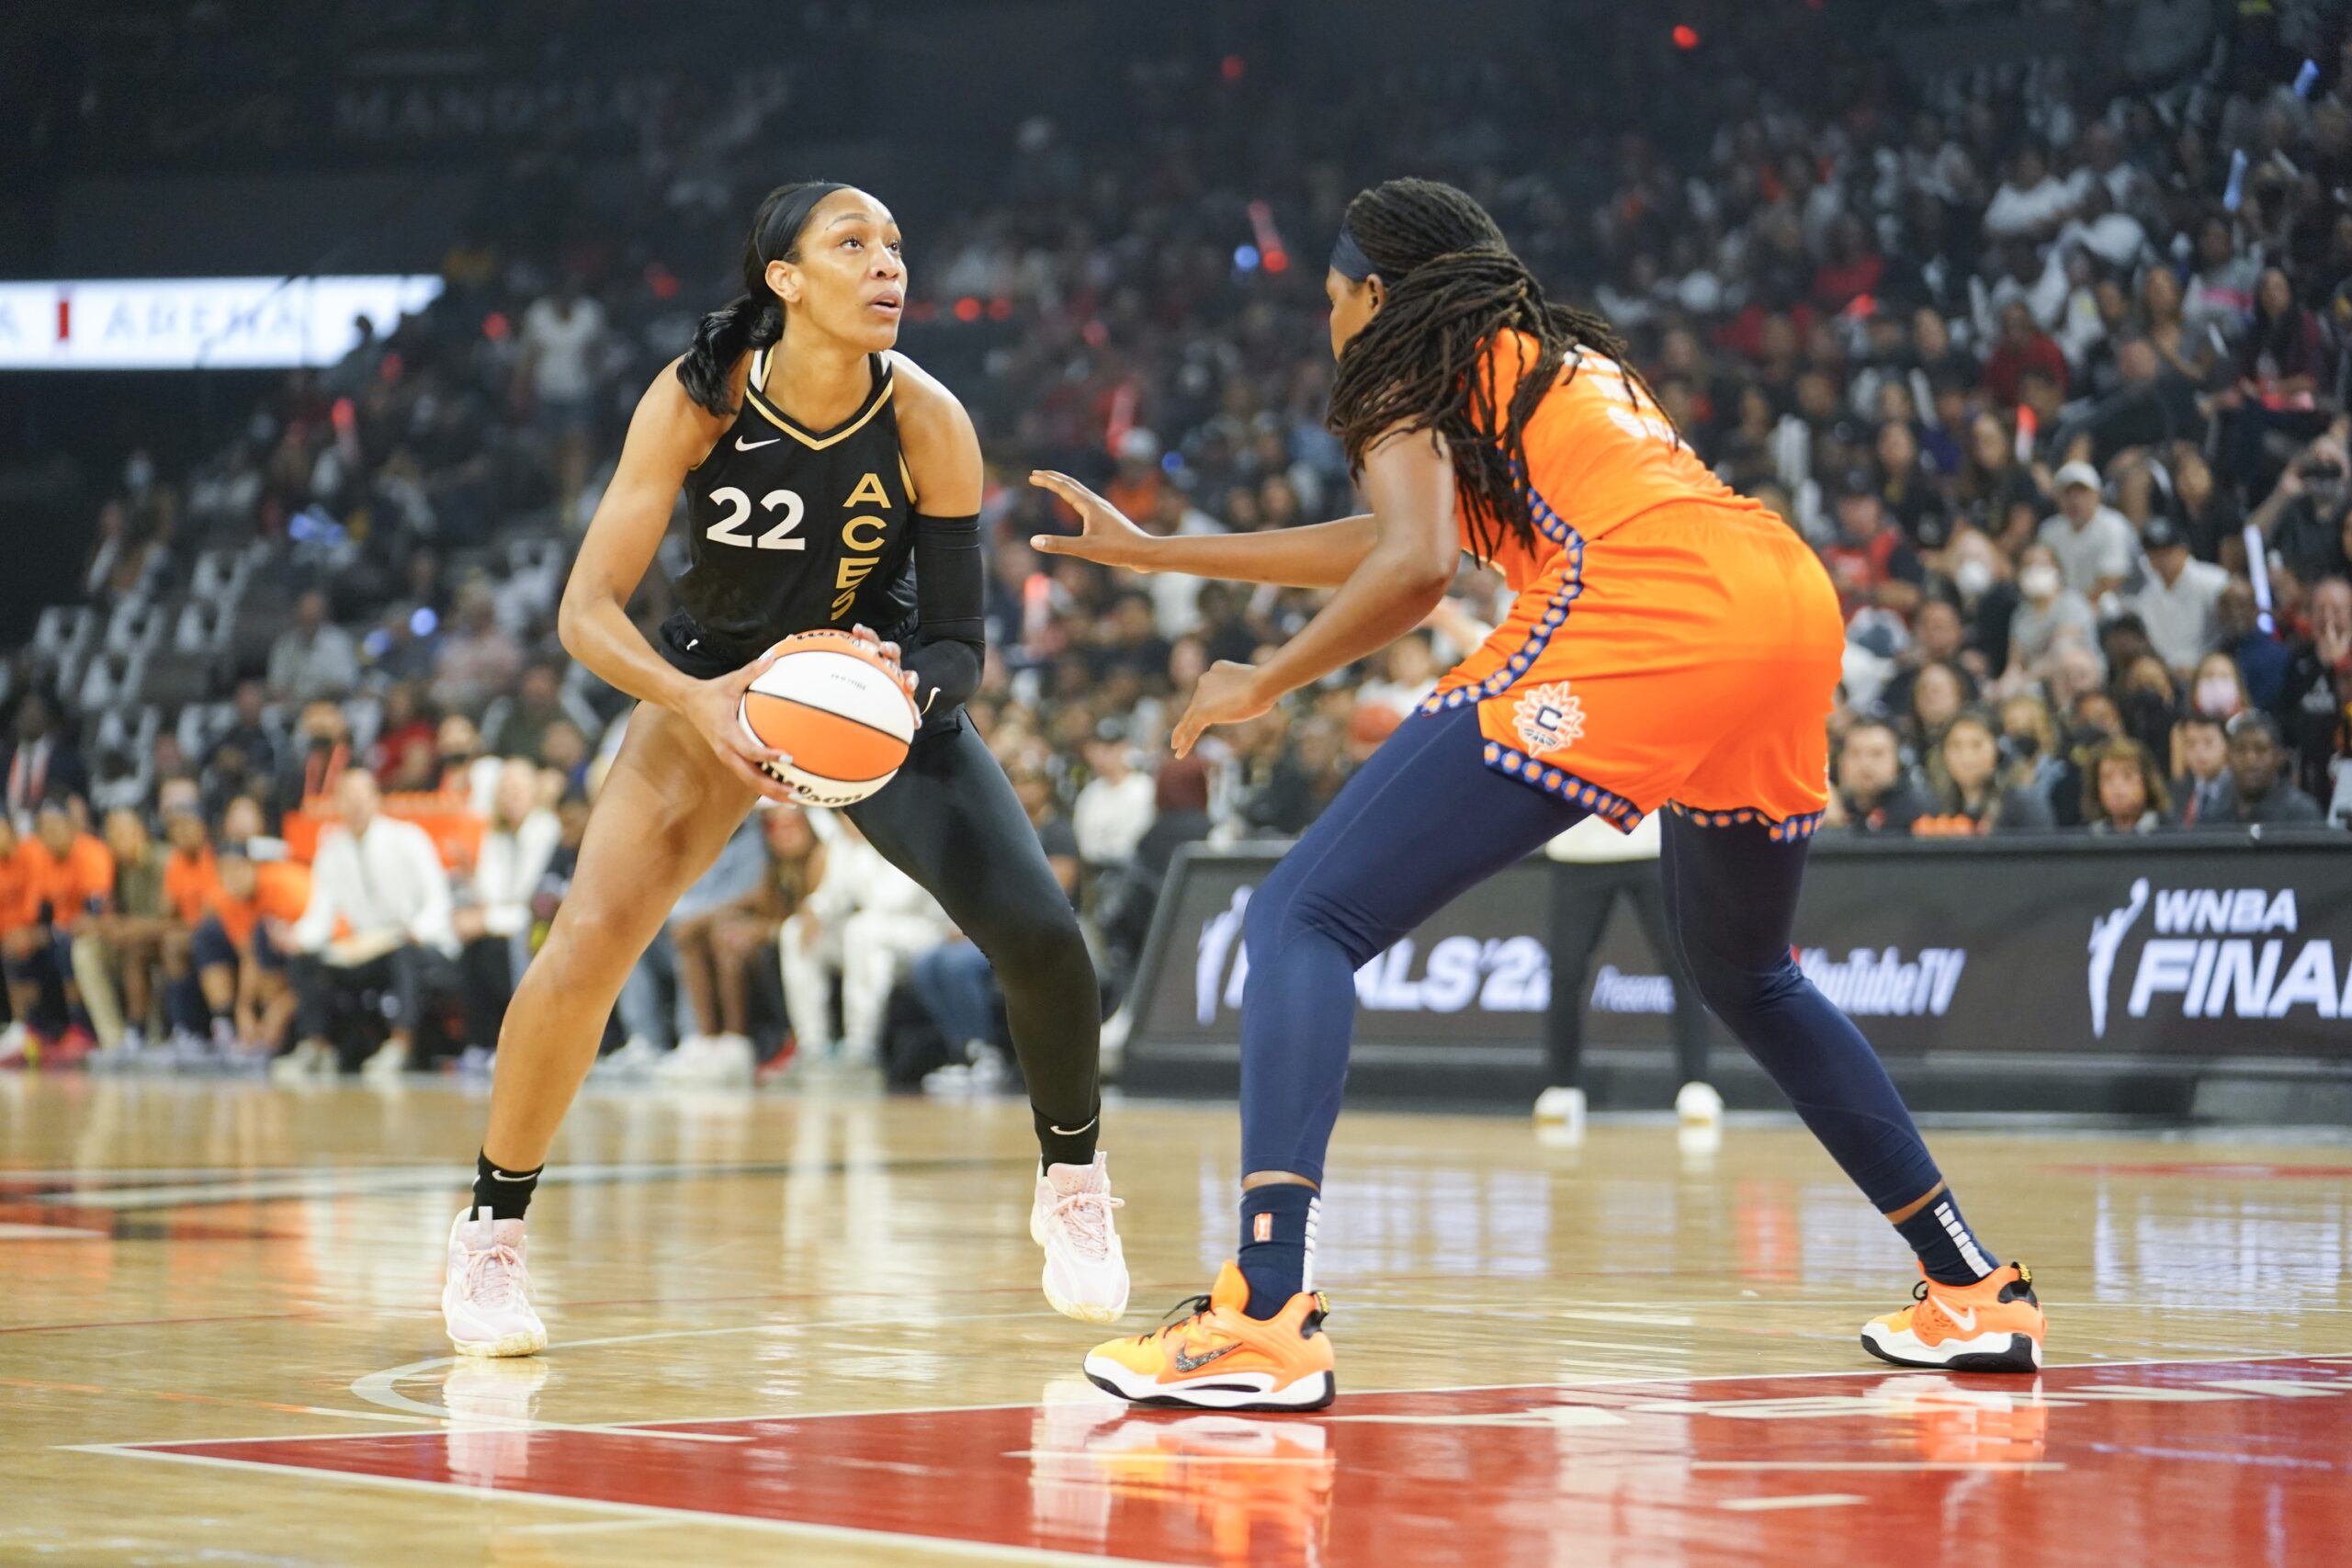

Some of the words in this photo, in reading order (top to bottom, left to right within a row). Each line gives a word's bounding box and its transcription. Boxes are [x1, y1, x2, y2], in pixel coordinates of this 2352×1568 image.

[706, 486, 806, 551] 22
[830, 472, 892, 622] ACES
[2154, 887, 2298, 934] WNBA
[2127, 938, 2352, 1019] FINA
